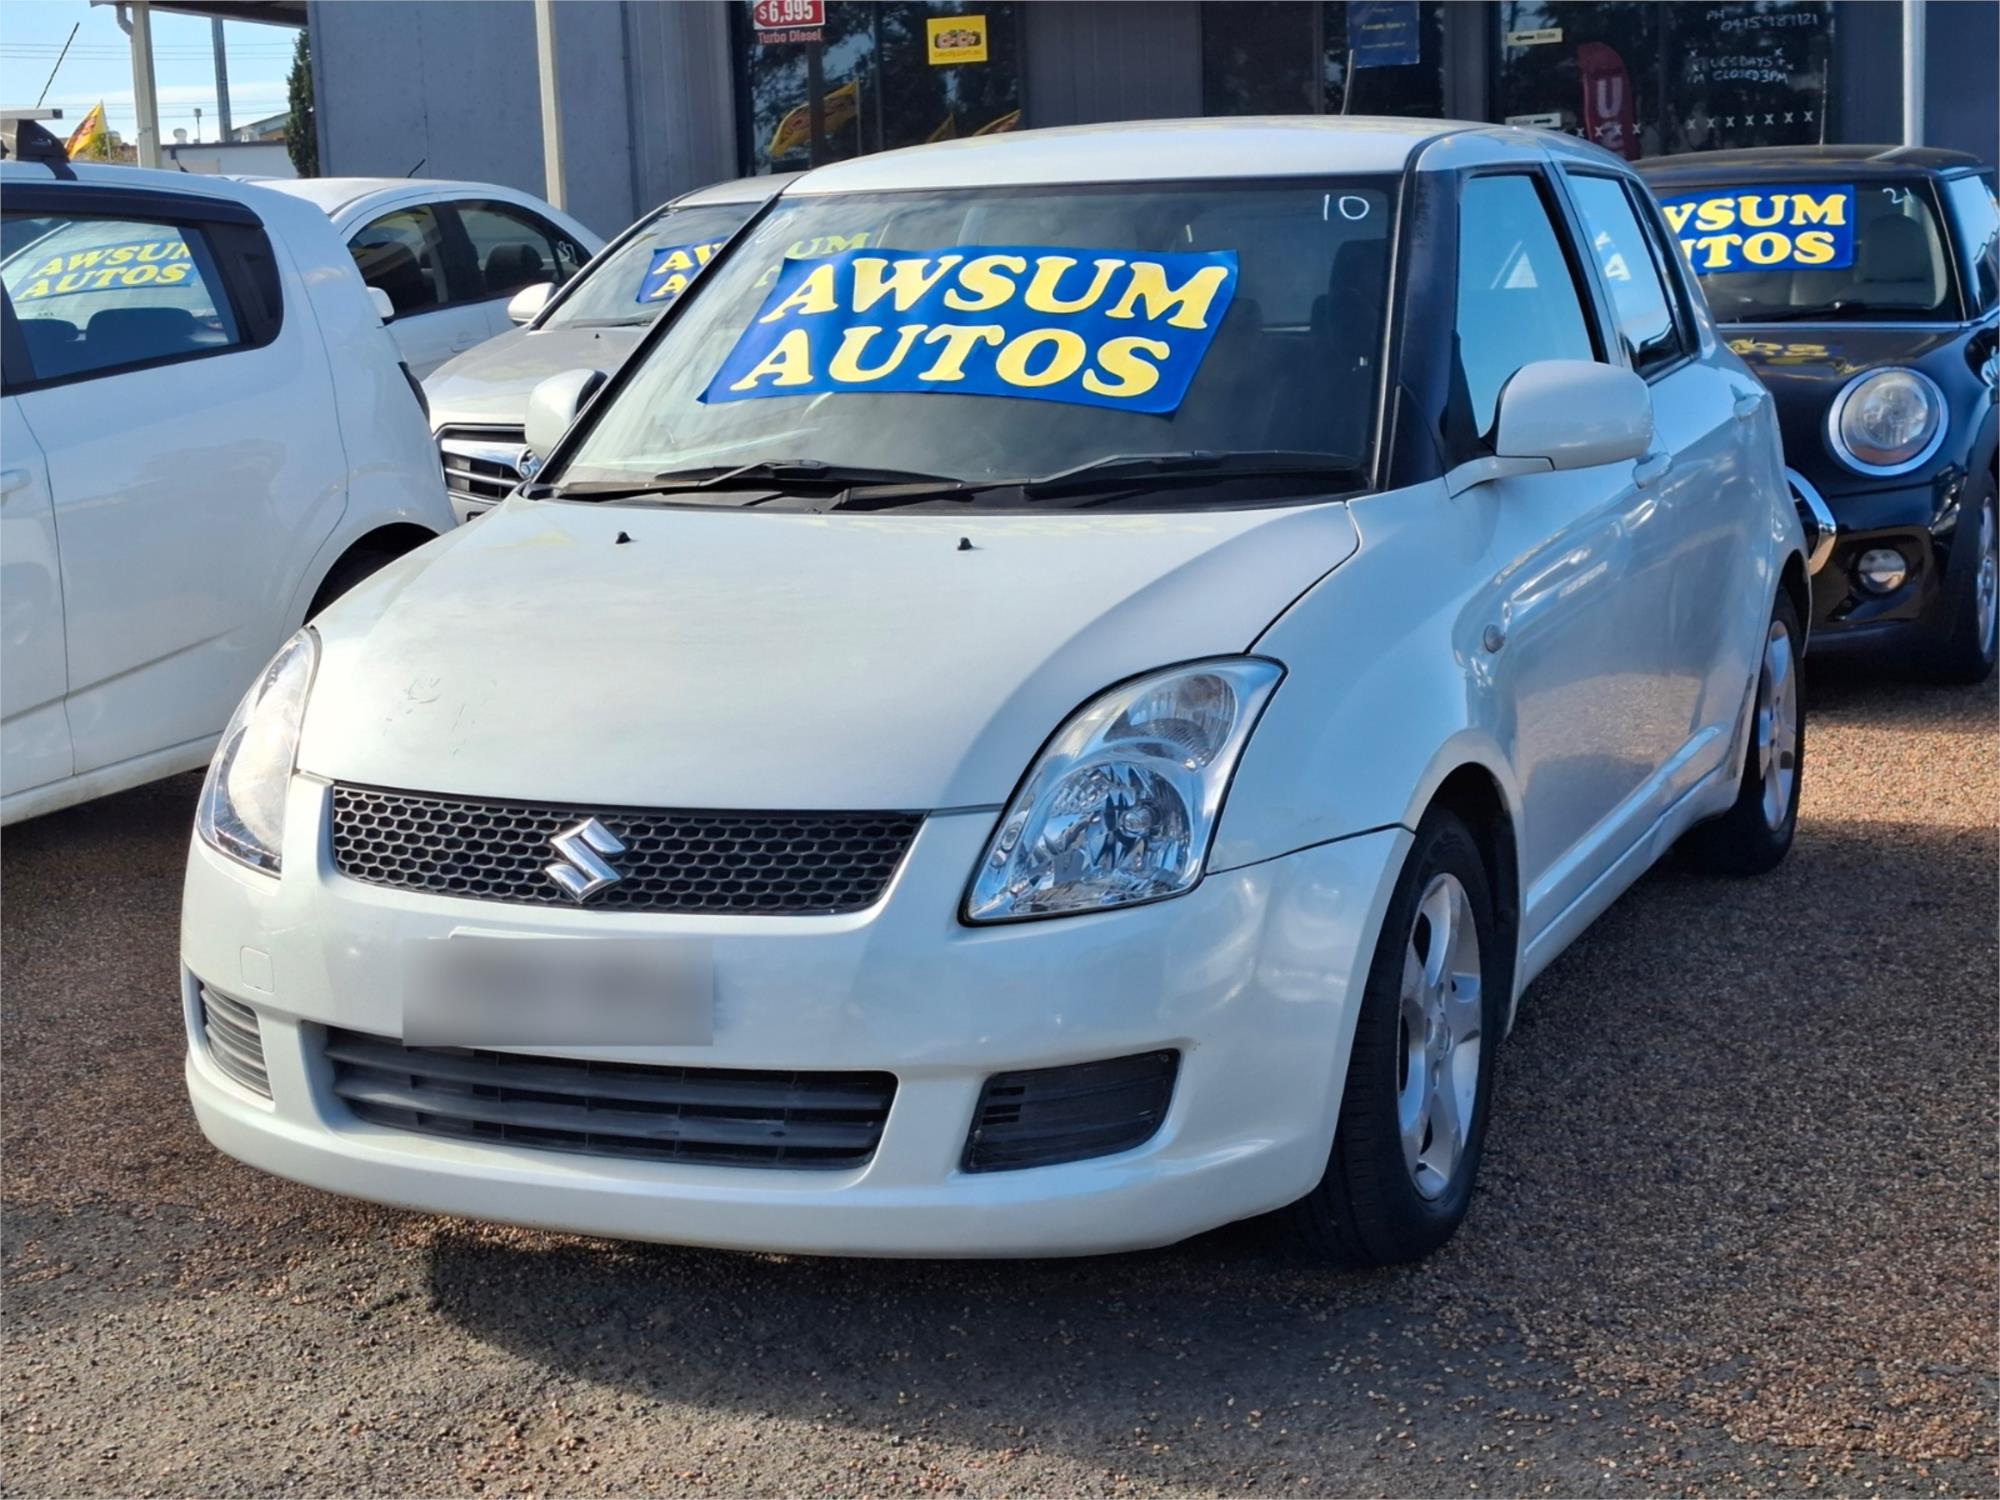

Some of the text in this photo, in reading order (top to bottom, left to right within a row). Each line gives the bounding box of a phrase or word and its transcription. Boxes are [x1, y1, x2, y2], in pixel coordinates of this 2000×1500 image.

[759, 1, 814, 23] $6,995
[758, 28, 822, 44] Turbo Diesel
[1322, 193, 1371, 222] 10
[1882, 187, 1914, 205] 21
[14, 263, 192, 301] AUTOS
[760, 253, 1230, 330] AWSUM
[730, 322, 1170, 397] AUTOS
